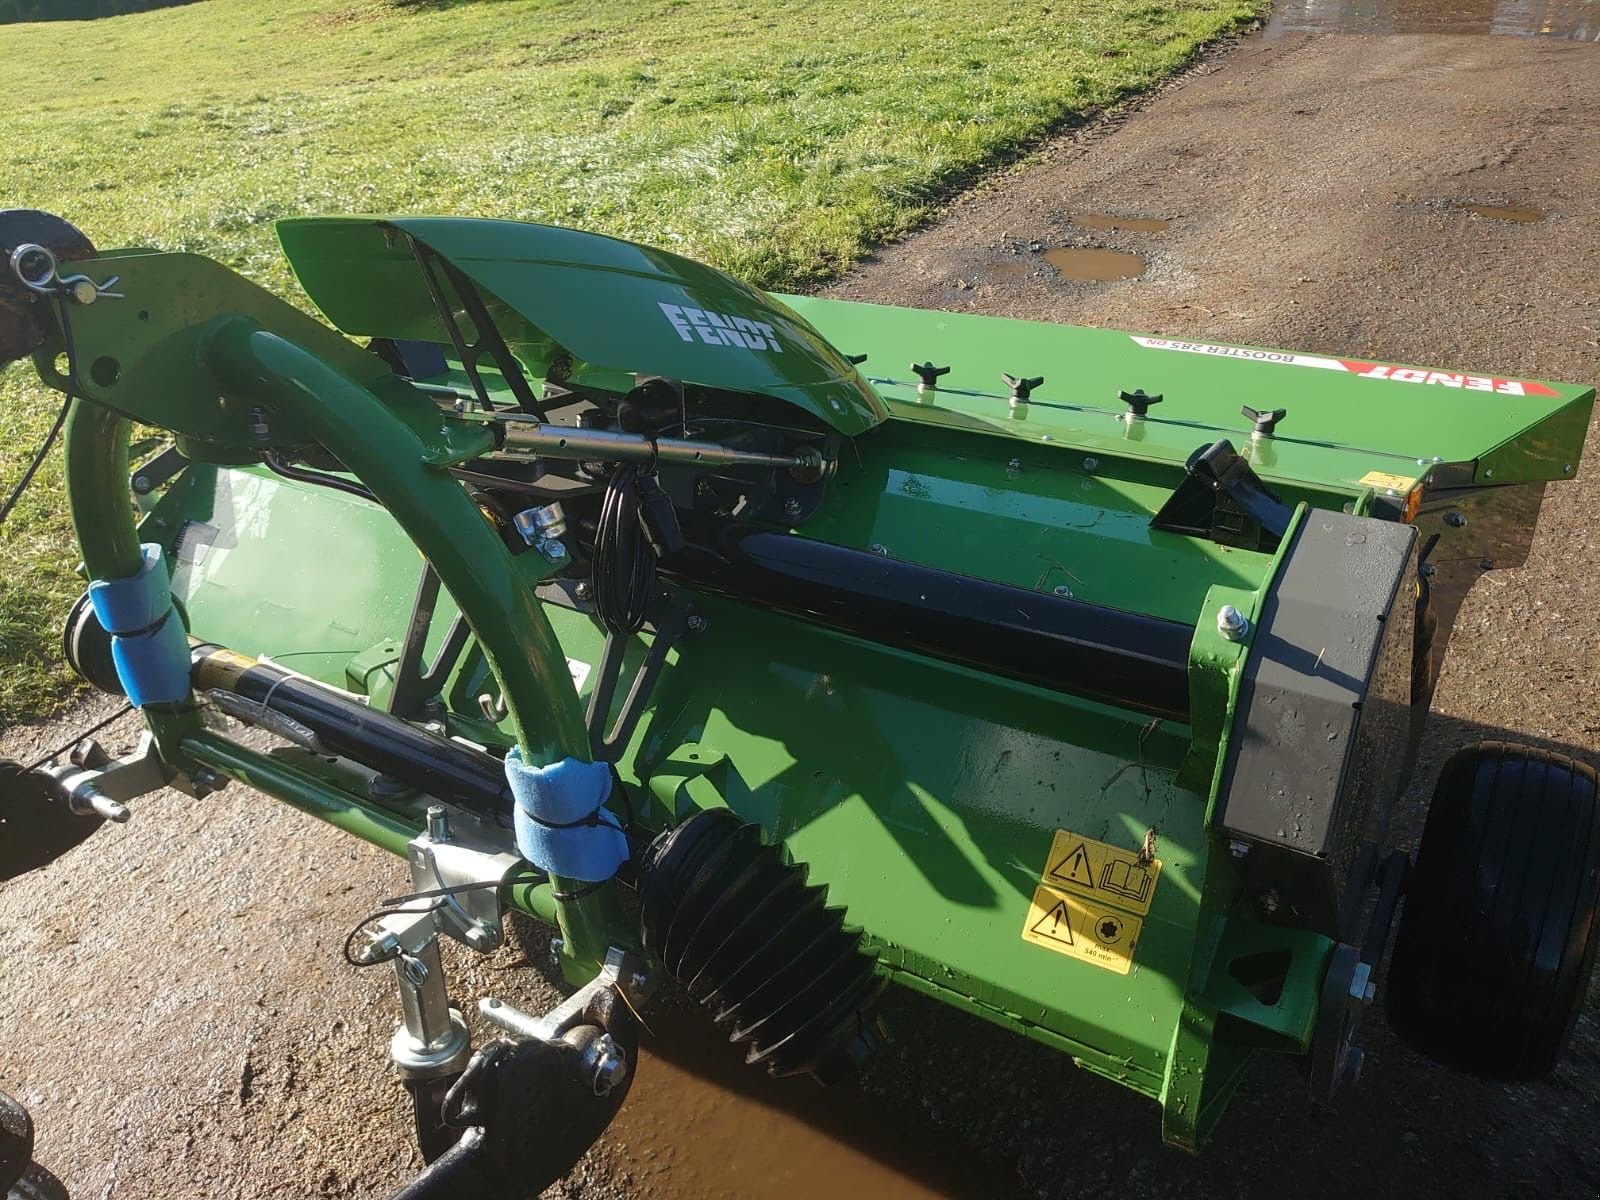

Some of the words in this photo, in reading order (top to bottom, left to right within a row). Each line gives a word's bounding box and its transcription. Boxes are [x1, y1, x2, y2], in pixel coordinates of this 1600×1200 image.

[656, 302, 783, 353] FENDT
[1170, 342, 1204, 352] 285
[1206, 346, 1295, 363] BOOSTER
[1358, 366, 1526, 396] FENDT
[1084, 947, 1098, 957] 540
